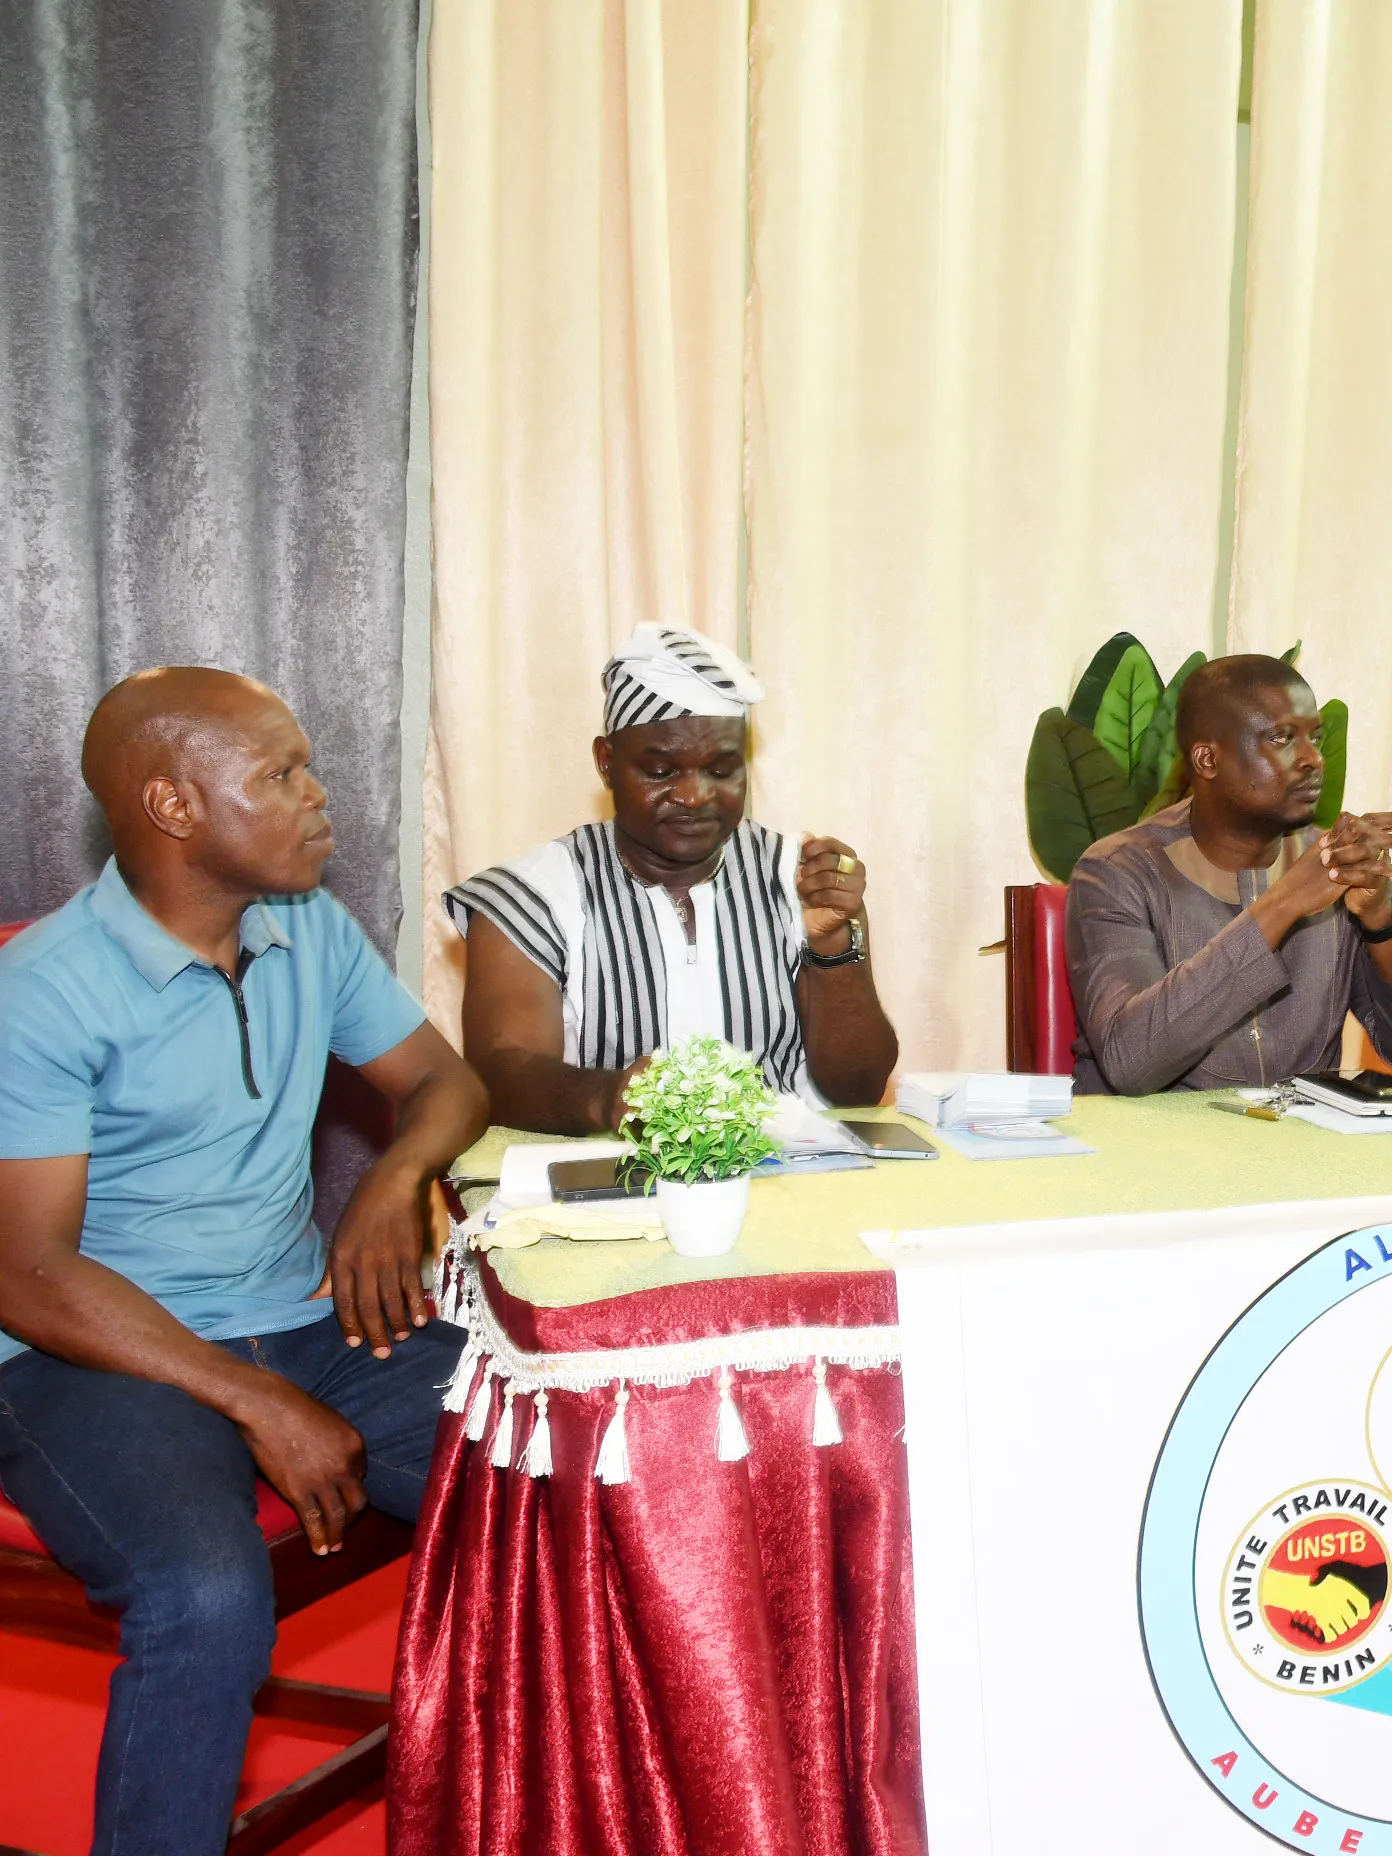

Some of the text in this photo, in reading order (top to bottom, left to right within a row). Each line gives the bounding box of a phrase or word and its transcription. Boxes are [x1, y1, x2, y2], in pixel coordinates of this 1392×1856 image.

[1231, 1535, 1268, 1631] UNITE
[1272, 1488, 1388, 1527] TRAVAIL
[1287, 1530, 1367, 1562] UNSTB
[1276, 1648, 1376, 1685] BENIN
[1210, 1750, 1363, 1854] AUBE
